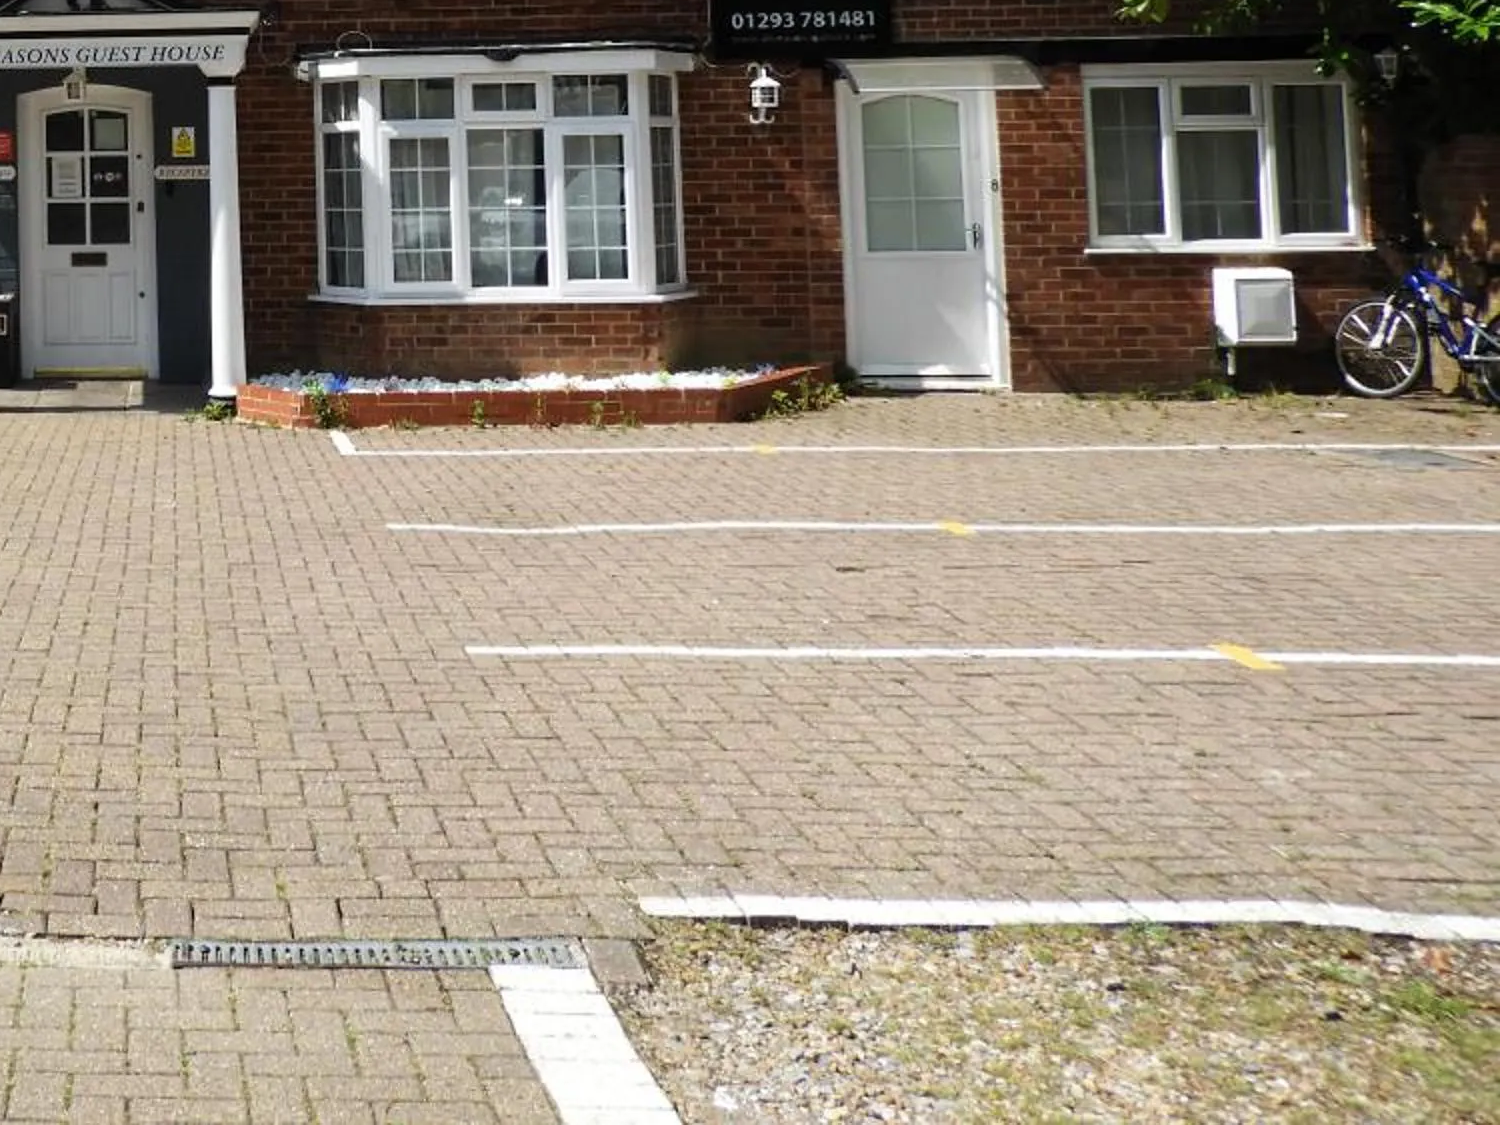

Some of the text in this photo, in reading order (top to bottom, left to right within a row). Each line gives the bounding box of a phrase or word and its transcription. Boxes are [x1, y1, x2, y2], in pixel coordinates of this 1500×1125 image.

[731, 10, 875, 30] 01293 781481
[75, 45, 146, 63] GUEST
[150, 43, 225, 62] HOUSE
